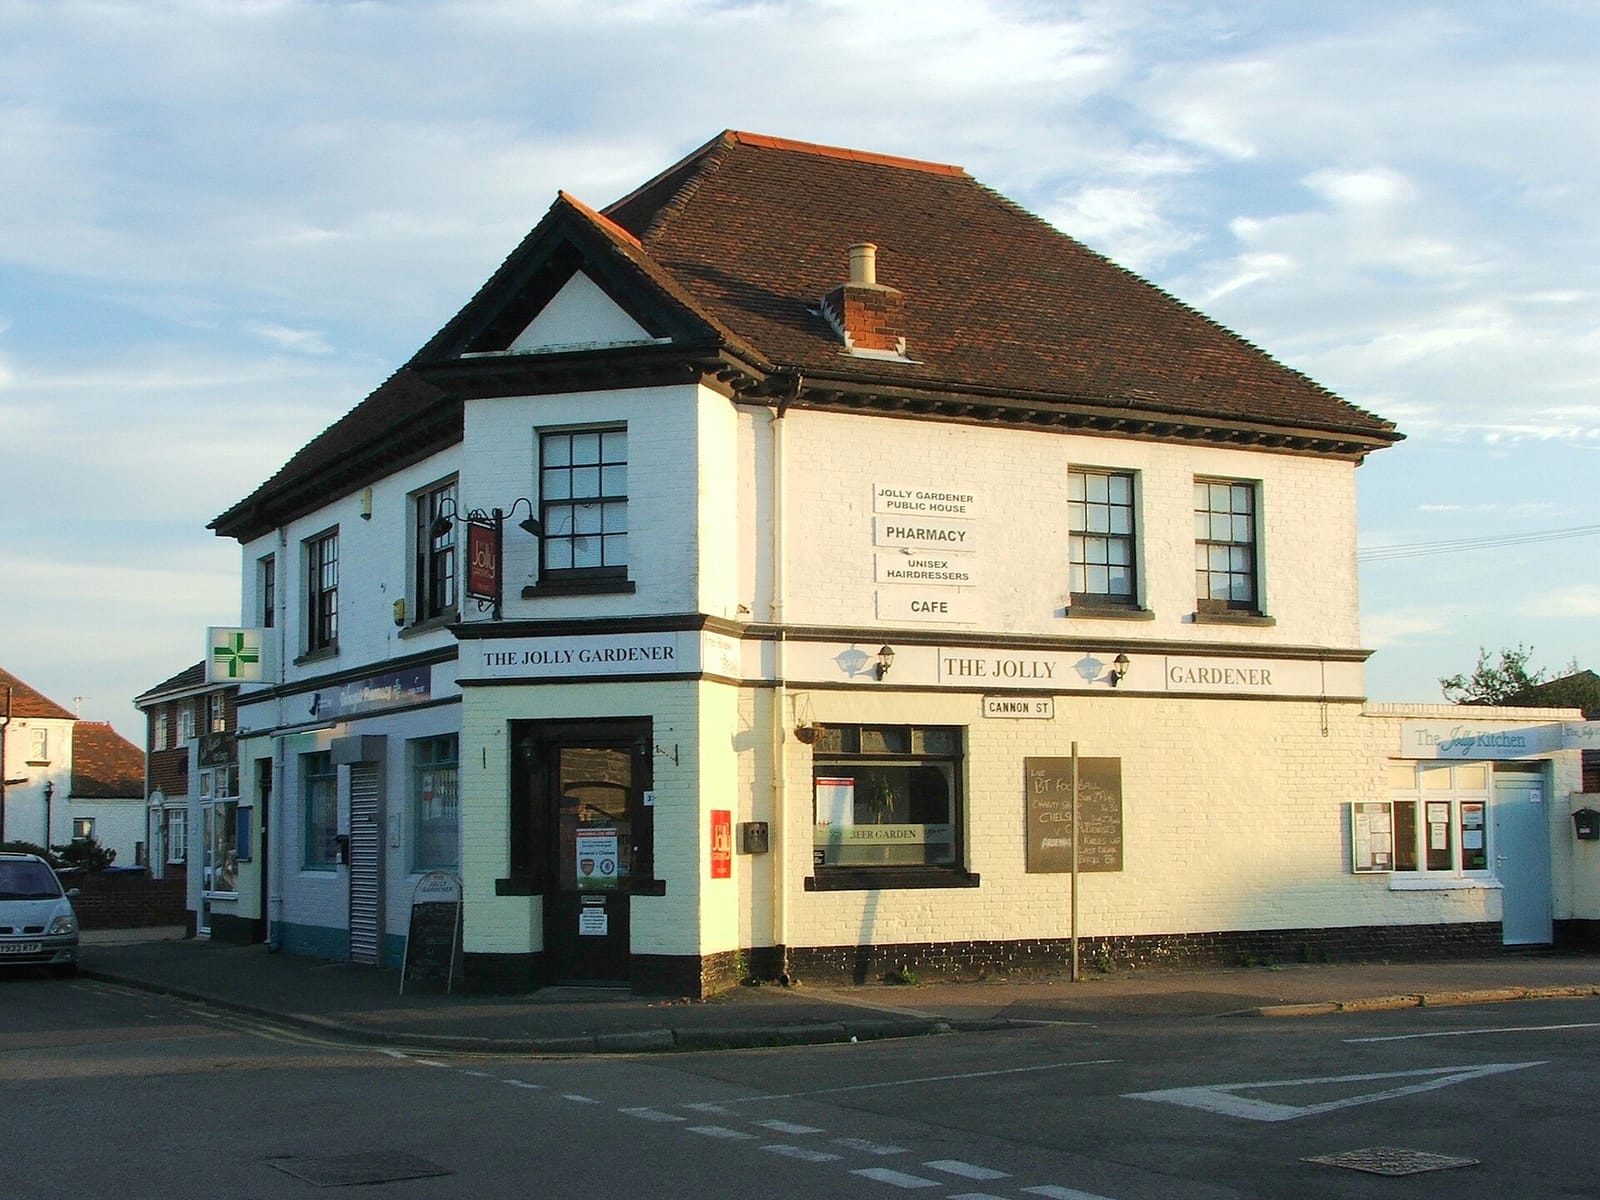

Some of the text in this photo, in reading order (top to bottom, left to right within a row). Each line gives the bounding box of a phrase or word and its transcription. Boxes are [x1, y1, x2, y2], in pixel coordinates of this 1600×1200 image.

[878, 488, 974, 503] JOLLY GARDENER
[887, 500, 966, 513] PUBLIC HOUSE
[886, 526, 966, 542] PHARMACY
[907, 559, 948, 569] UNISEX
[887, 570, 969, 581] HAIRDRESSERS
[911, 600, 948, 613] CAFE
[483, 646, 675, 667] THE JOLLY GARDENER
[944, 658, 1057, 680] THE JOLLY
[1170, 666, 1272, 686] GARDENER
[989, 701, 1049, 714] CANNON ST
[1415, 729, 1441, 746] The
[1477, 731, 1527, 748] Kitchen
[1034, 777, 1051, 794] BT
[875, 829, 917, 839] GARDEN
